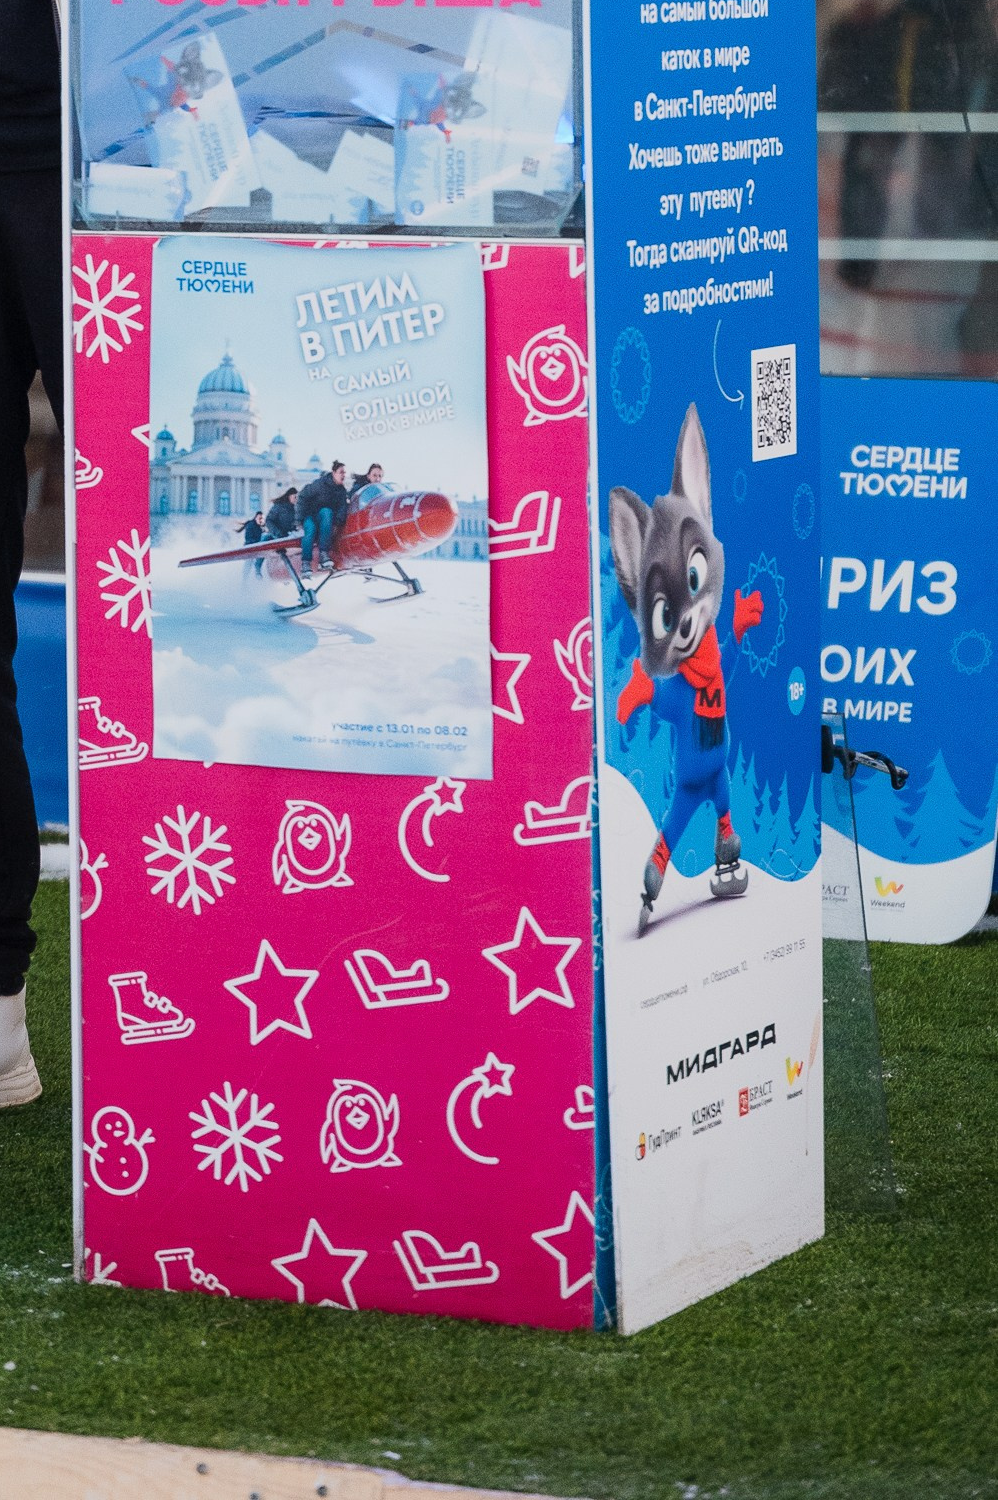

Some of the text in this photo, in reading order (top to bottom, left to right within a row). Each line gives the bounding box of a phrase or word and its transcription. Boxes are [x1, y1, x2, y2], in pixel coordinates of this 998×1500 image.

[640, 3, 658, 24] на
[661, 45, 750, 73] каток в мире
[634, 84, 777, 122] в Санкт-Петербурге!
[628, 136, 784, 170] Хочешь тоже выиграть
[660, 179, 755, 221] эту путевку ?
[626, 225, 788, 270] Тогда сканируй QR-код
[182, 260, 247, 277] СЕРДЦЕ
[295, 271, 420, 328] ЛЕТИМ
[643, 271, 774, 315] за подробностями!
[299, 303, 445, 364] В ПИТЕР
[308, 358, 412, 395] НА САМЫЙ
[340, 381, 452, 424] БОЛЬШОЙ
[344, 405, 456, 441] КАТОК В МИРЕ
[851, 444, 961, 474] СЕРДЦЕ
[820, 556, 958, 615] РИЗ
[789, 682, 804, 701] 18+
[844, 698, 913, 723] МИРЕ
[376, 725, 383, 733] с
[386, 723, 414, 734] 13.01
[417, 726, 431, 735] по
[434, 726, 468, 736] 08.02
[666, 1023, 777, 1085] МИДГАРД
